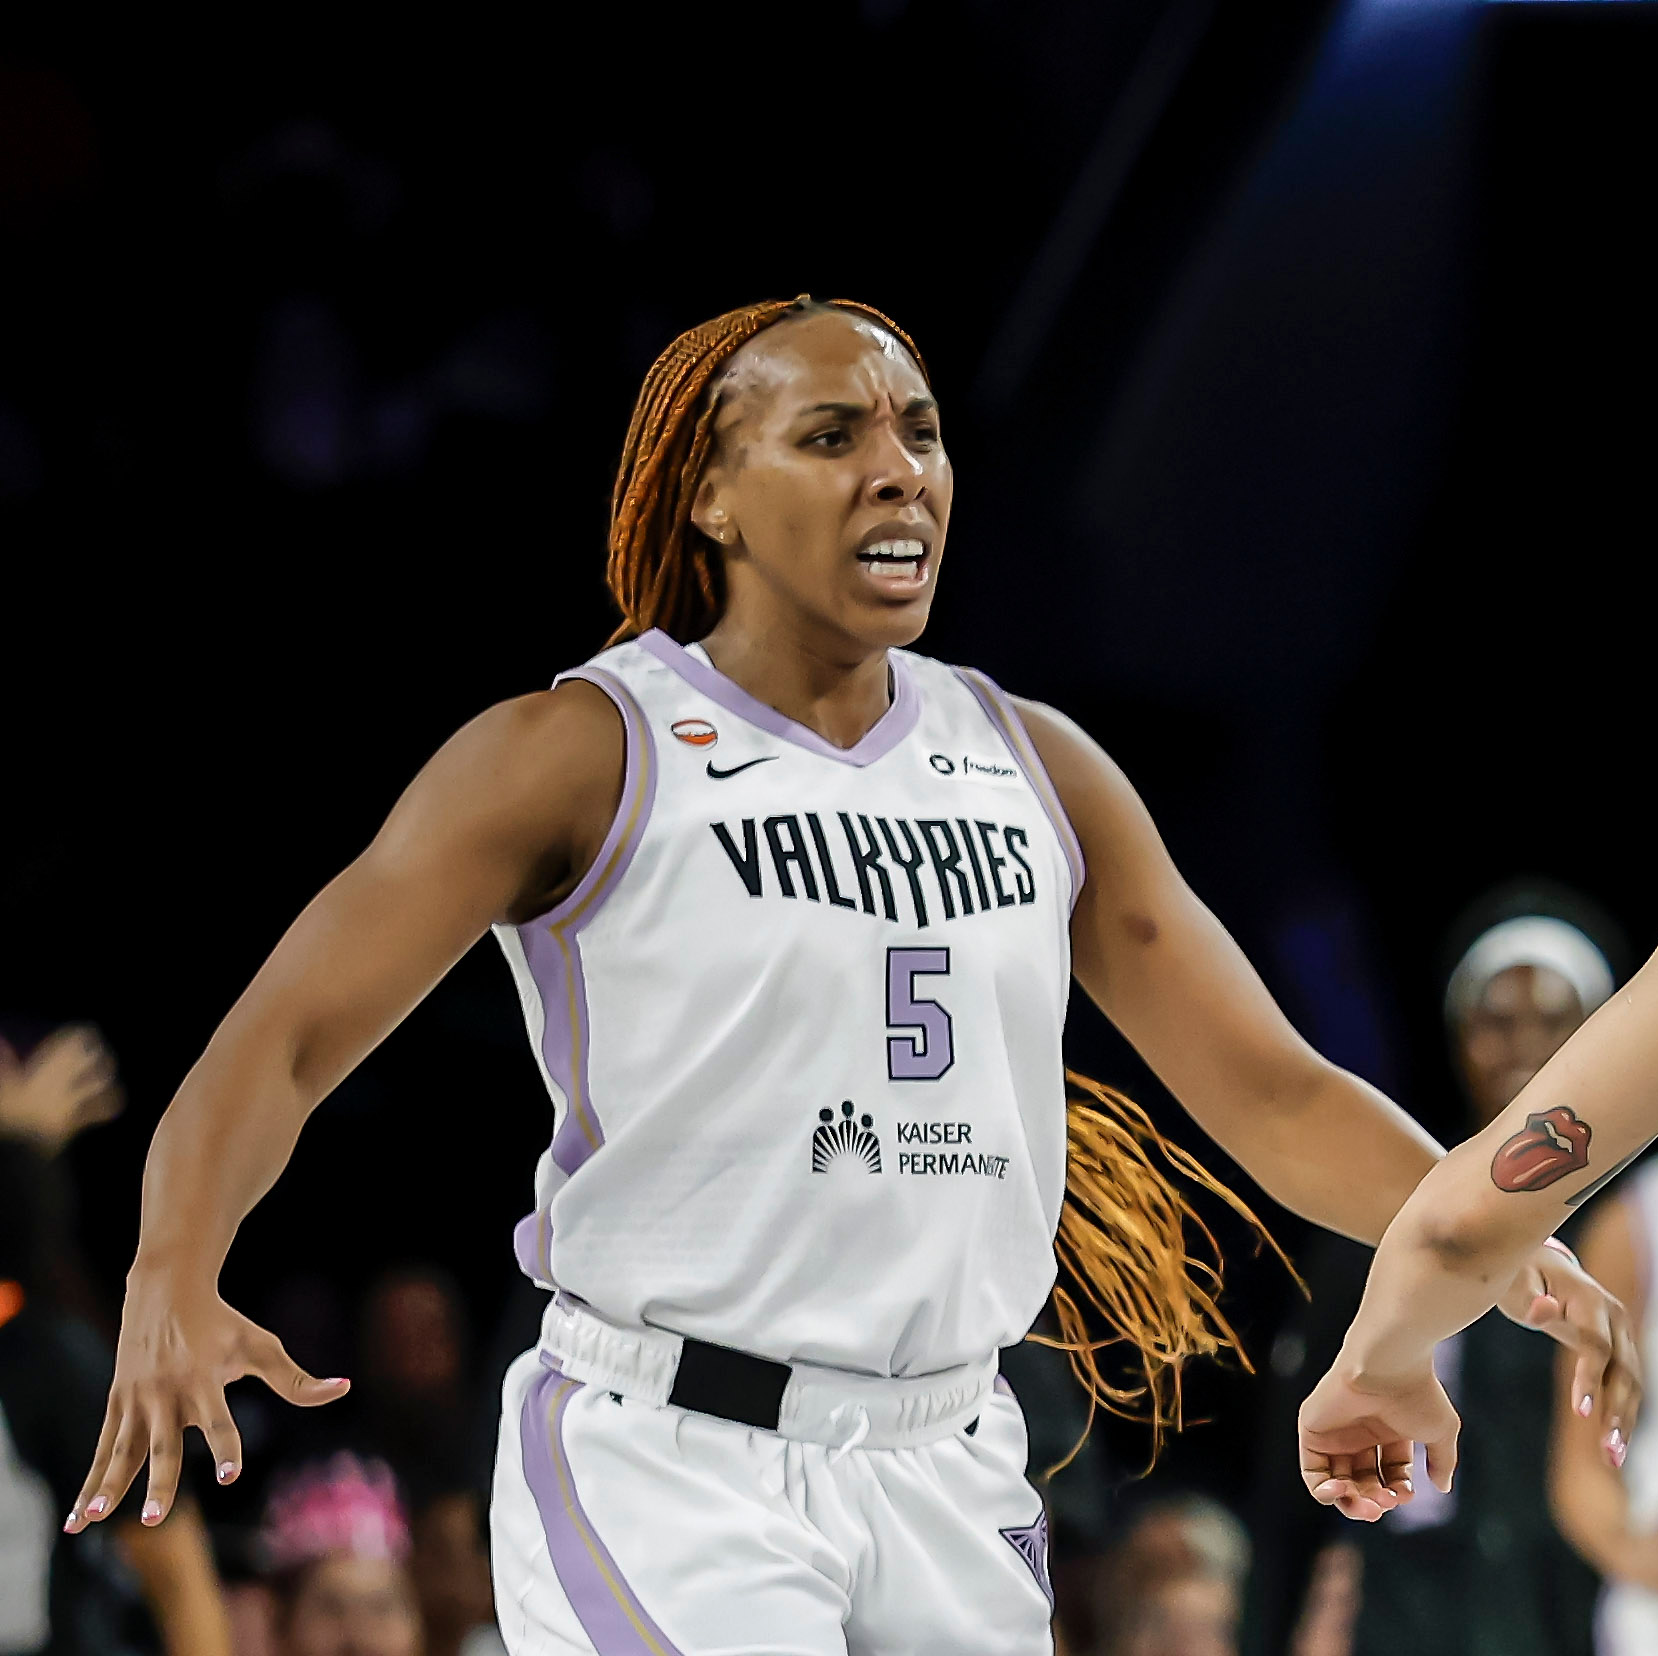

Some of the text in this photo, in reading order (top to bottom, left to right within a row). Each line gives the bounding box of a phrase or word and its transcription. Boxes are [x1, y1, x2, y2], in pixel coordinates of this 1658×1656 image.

[709, 811, 1036, 929] VALKYRIES
[884, 945, 956, 1083] 5
[897, 1121, 972, 1145] KAISER
